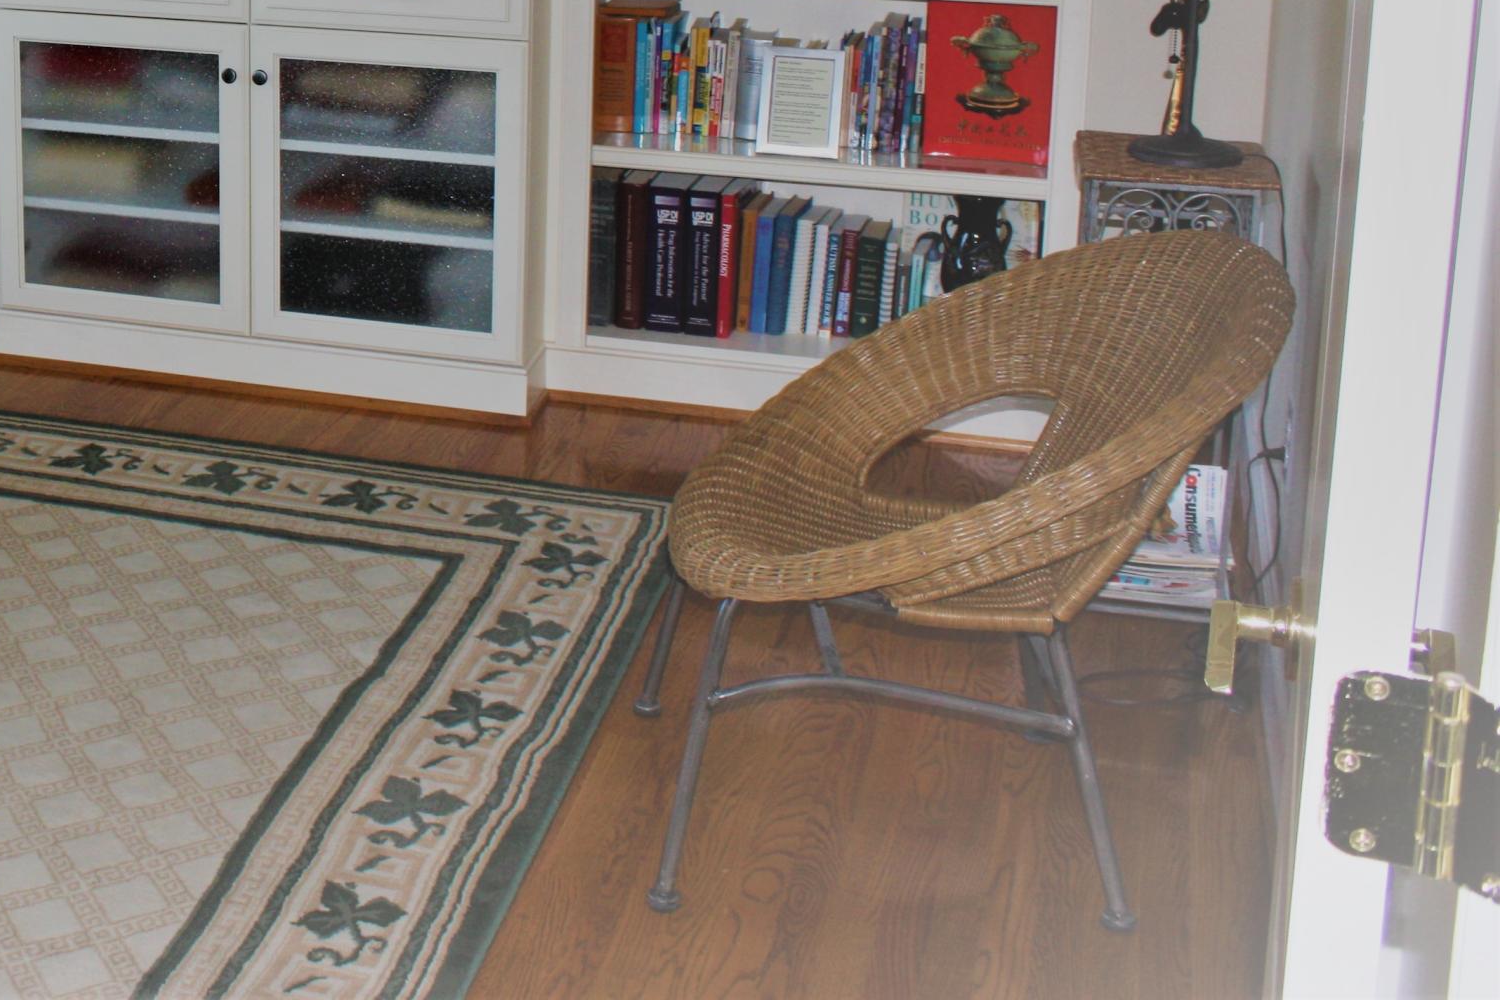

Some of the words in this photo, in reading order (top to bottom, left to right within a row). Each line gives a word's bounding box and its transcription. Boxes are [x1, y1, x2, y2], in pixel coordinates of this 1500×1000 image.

[702, 232, 710, 254] Advice
[719, 223, 733, 278] PHARMACOLOGY
[827, 243, 838, 271] AUTISM
[1185, 467, 1203, 537] Consumer
